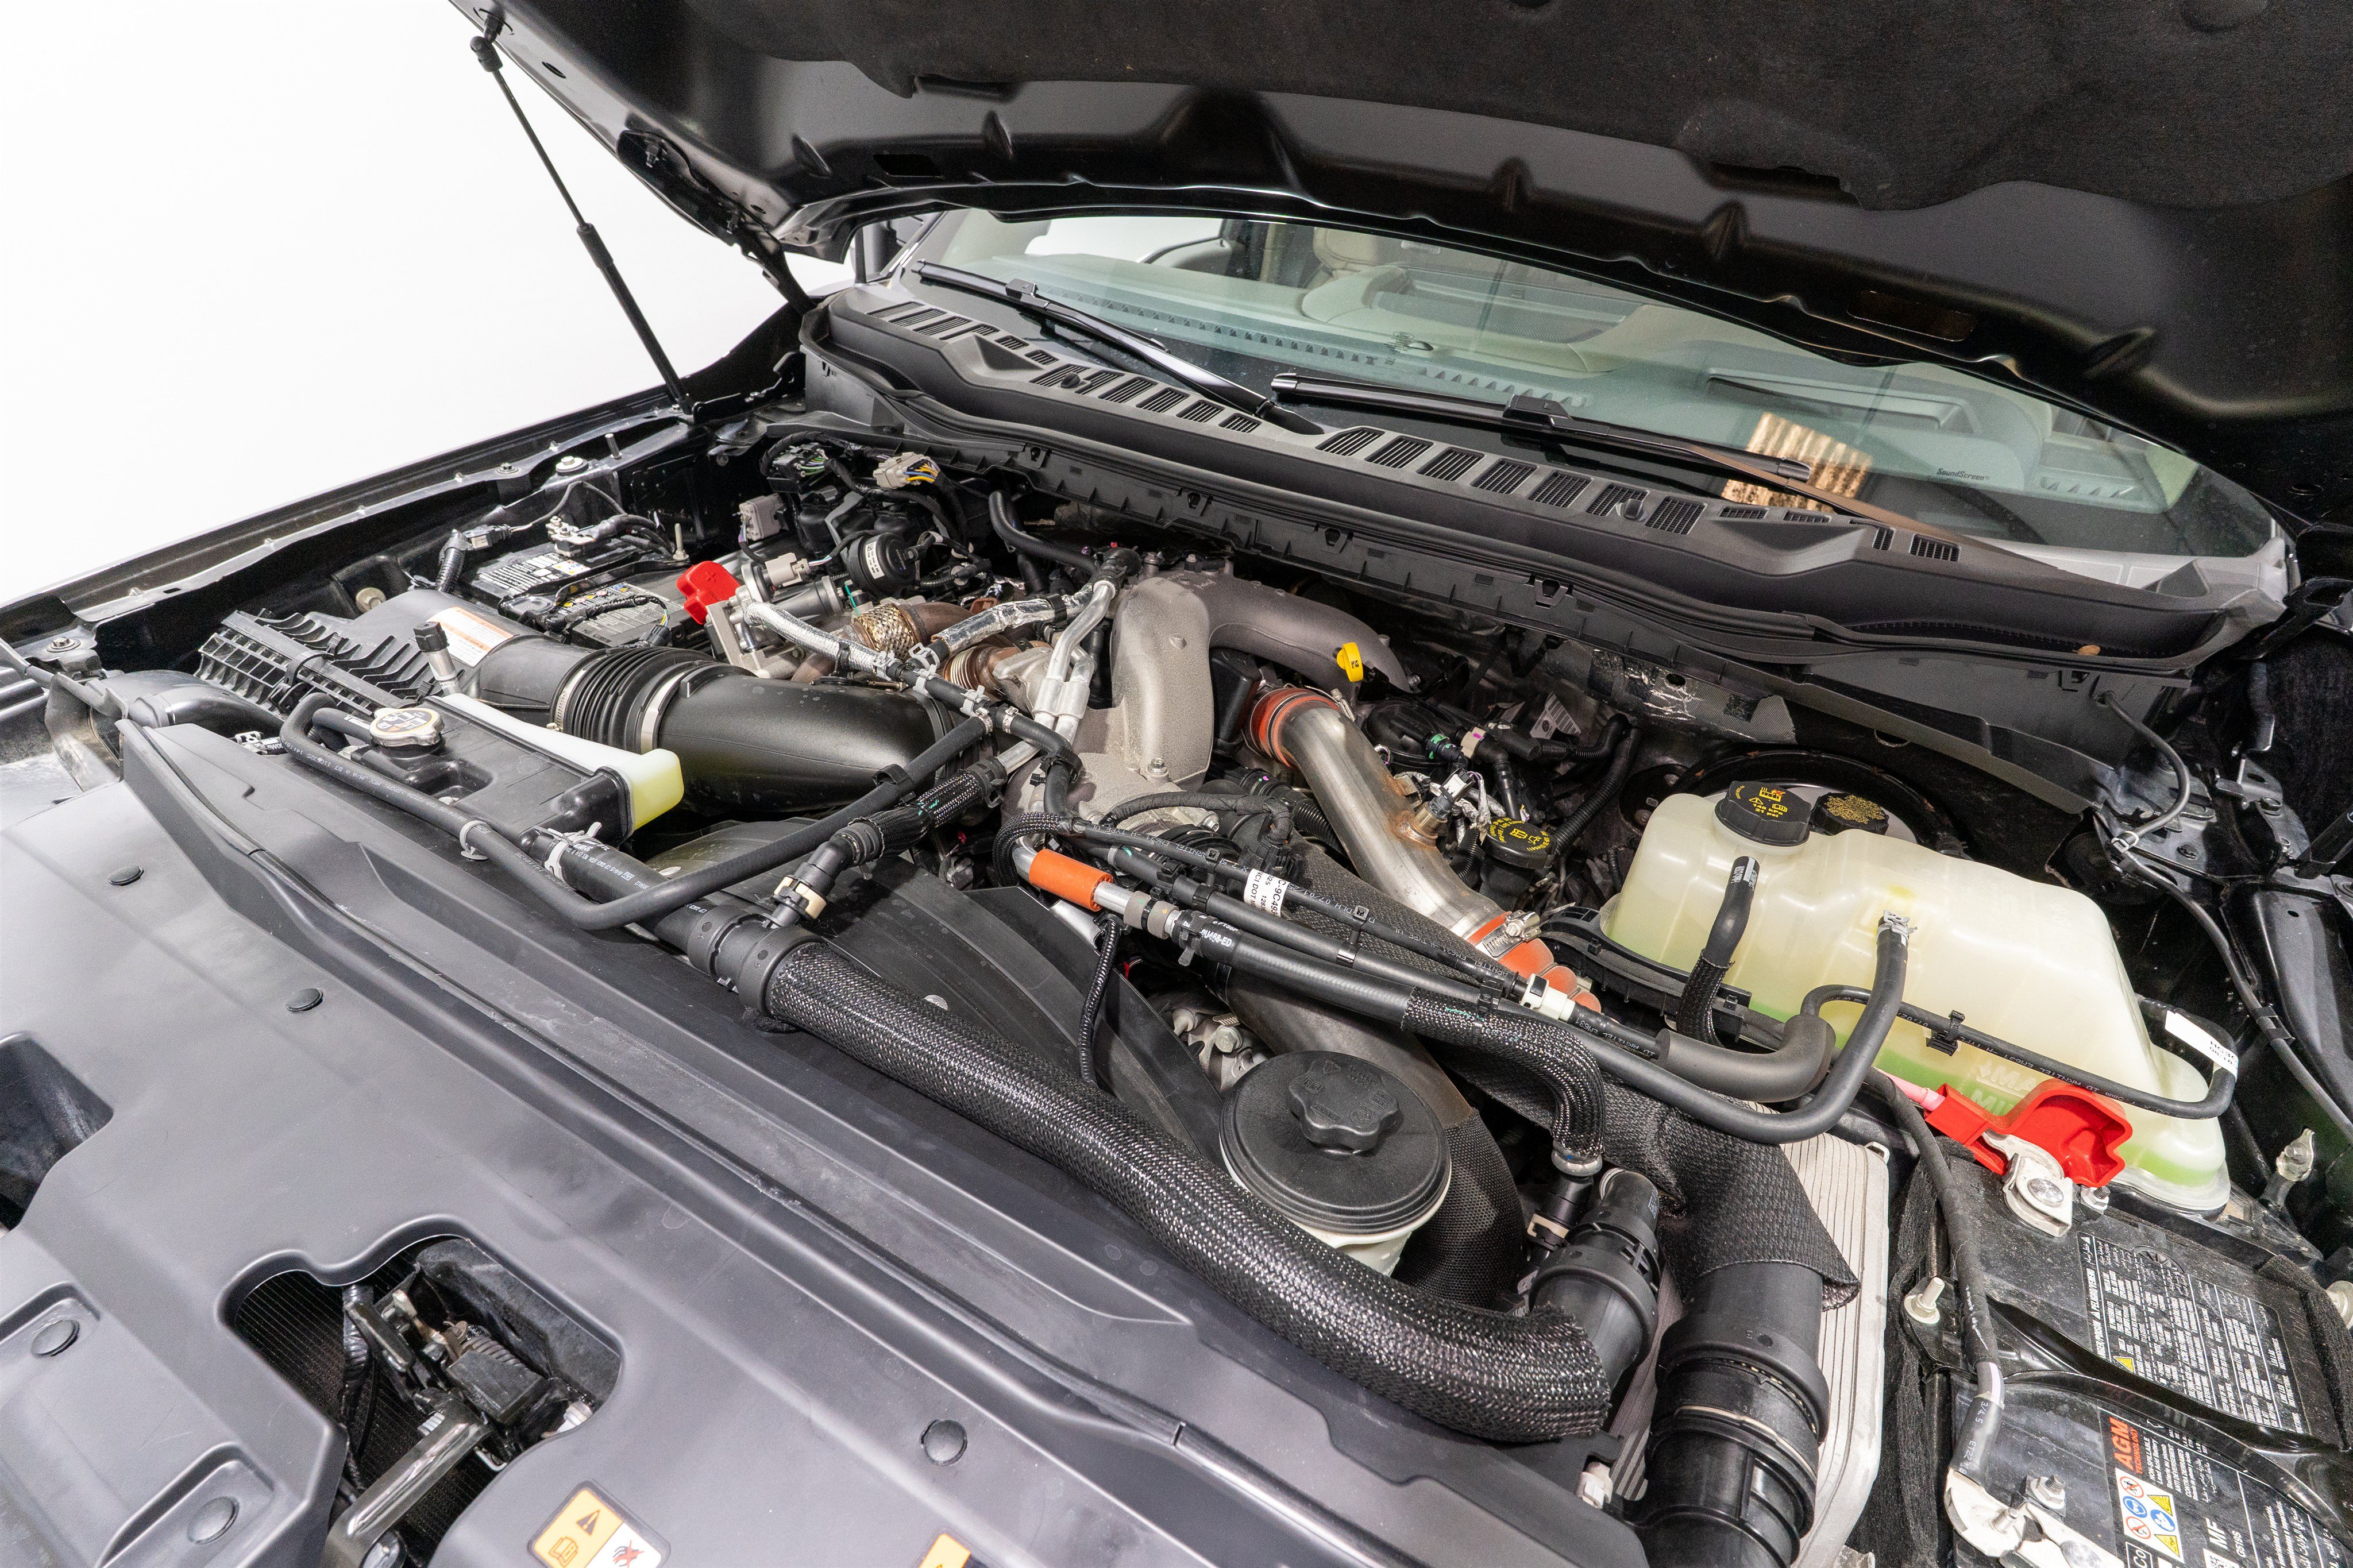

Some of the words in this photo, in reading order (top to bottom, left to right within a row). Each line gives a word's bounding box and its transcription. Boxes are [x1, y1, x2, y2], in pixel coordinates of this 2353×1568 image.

[1090, 822, 1101, 831] UL
[1104, 824, 1126, 836] TYPE
[1249, 883, 1259, 899] DOT
[2277, 1382, 2286, 1394] LES
[2279, 1392, 2289, 1404] LIRE
[1962, 1439, 1978, 1461] ET22
[2108, 1415, 2135, 1471] AGM
[2129, 1426, 2144, 1475] TECHNOLOGY
[2150, 1438, 2161, 1458] Battery
[2160, 1442, 2169, 1461] plomb
[2143, 1435, 2156, 1481] NON-SPILLABLE
[2153, 1456, 2161, 1470] Acid
[2164, 1460, 2170, 1468] au
[2166, 1442, 2180, 1481] DÉVERSEMENT
[2177, 1447, 2188, 1477] DERRAMES
[2155, 1469, 2163, 1485] Lead
[2163, 1466, 2173, 1489] Batterie
[2173, 1478, 2182, 1493] ANTI
[2182, 1475, 2192, 1498] CONTRA
[2204, 1516, 2228, 1550] MF
